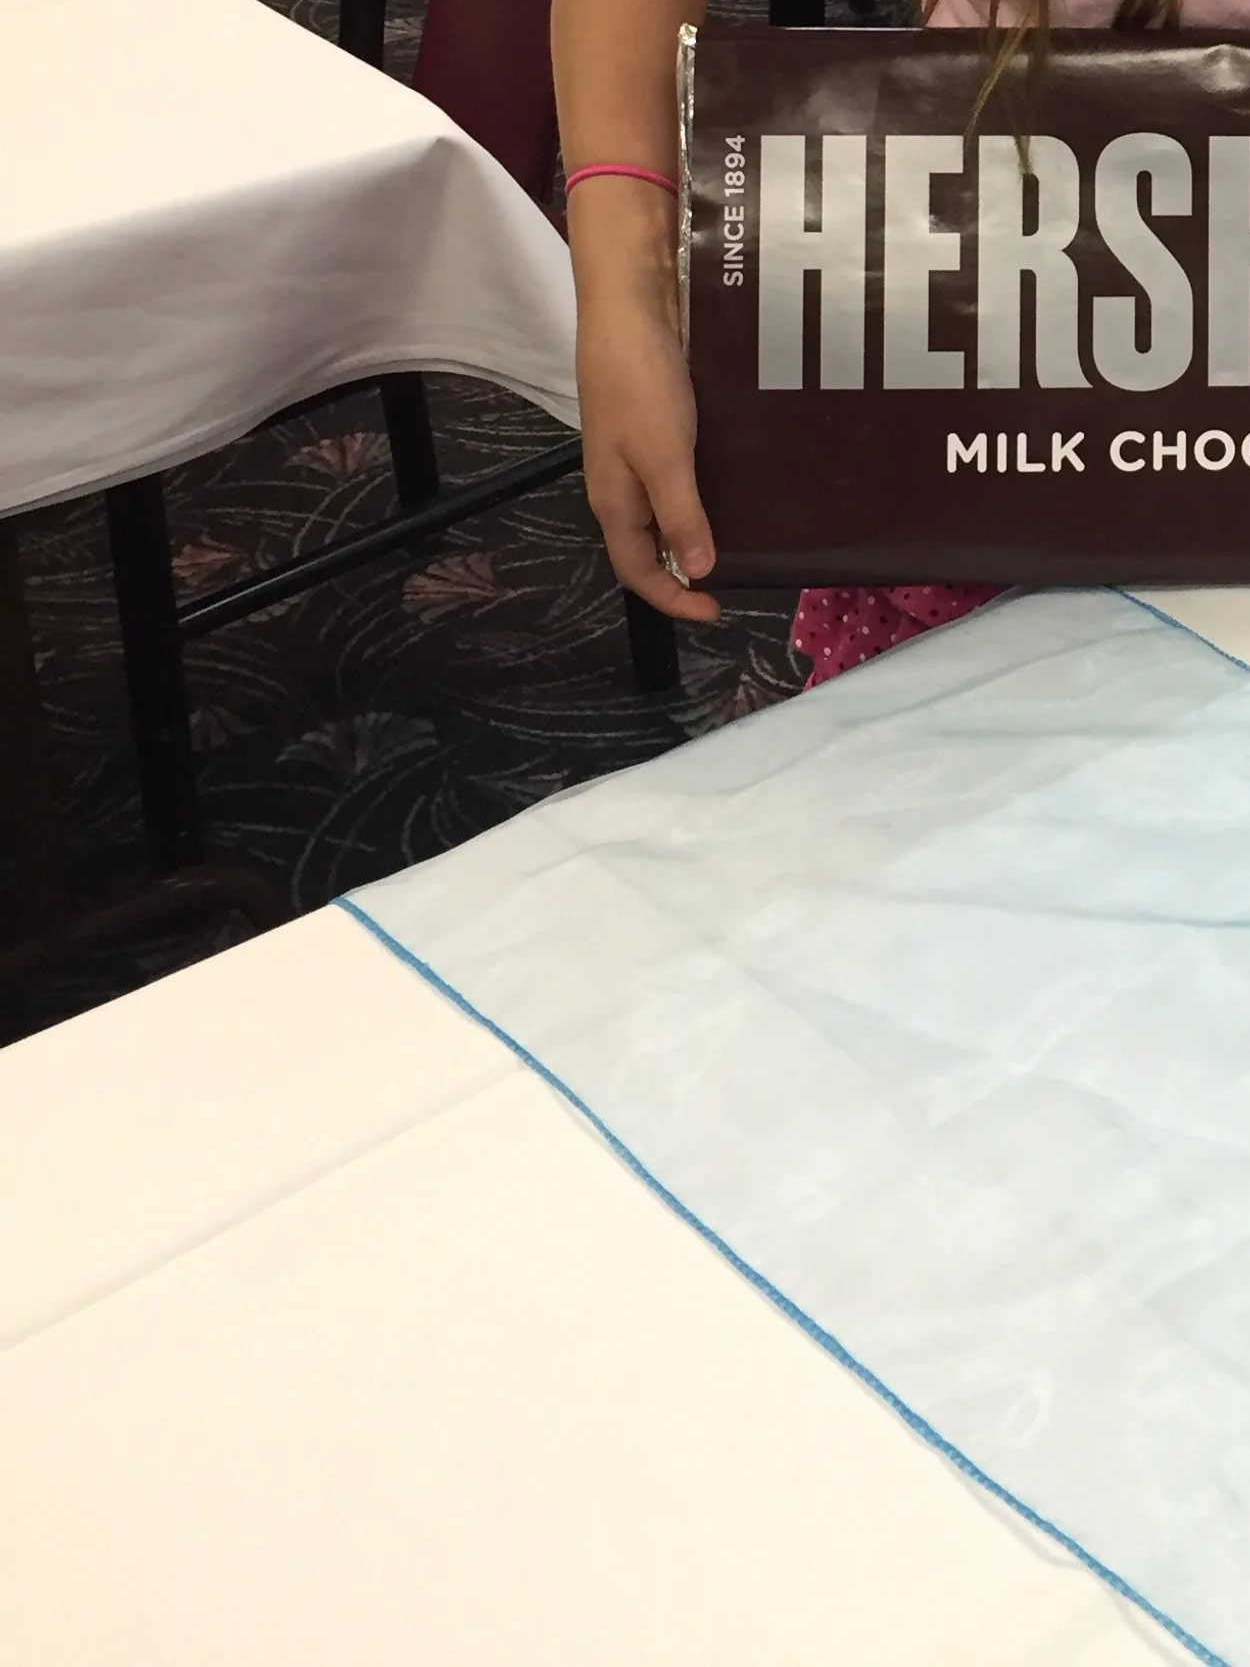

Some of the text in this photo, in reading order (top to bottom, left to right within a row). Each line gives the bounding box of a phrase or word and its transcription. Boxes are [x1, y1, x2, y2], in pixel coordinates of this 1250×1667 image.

[722, 134, 746, 287] SINCE 1894
[946, 430, 1086, 474] MILK
